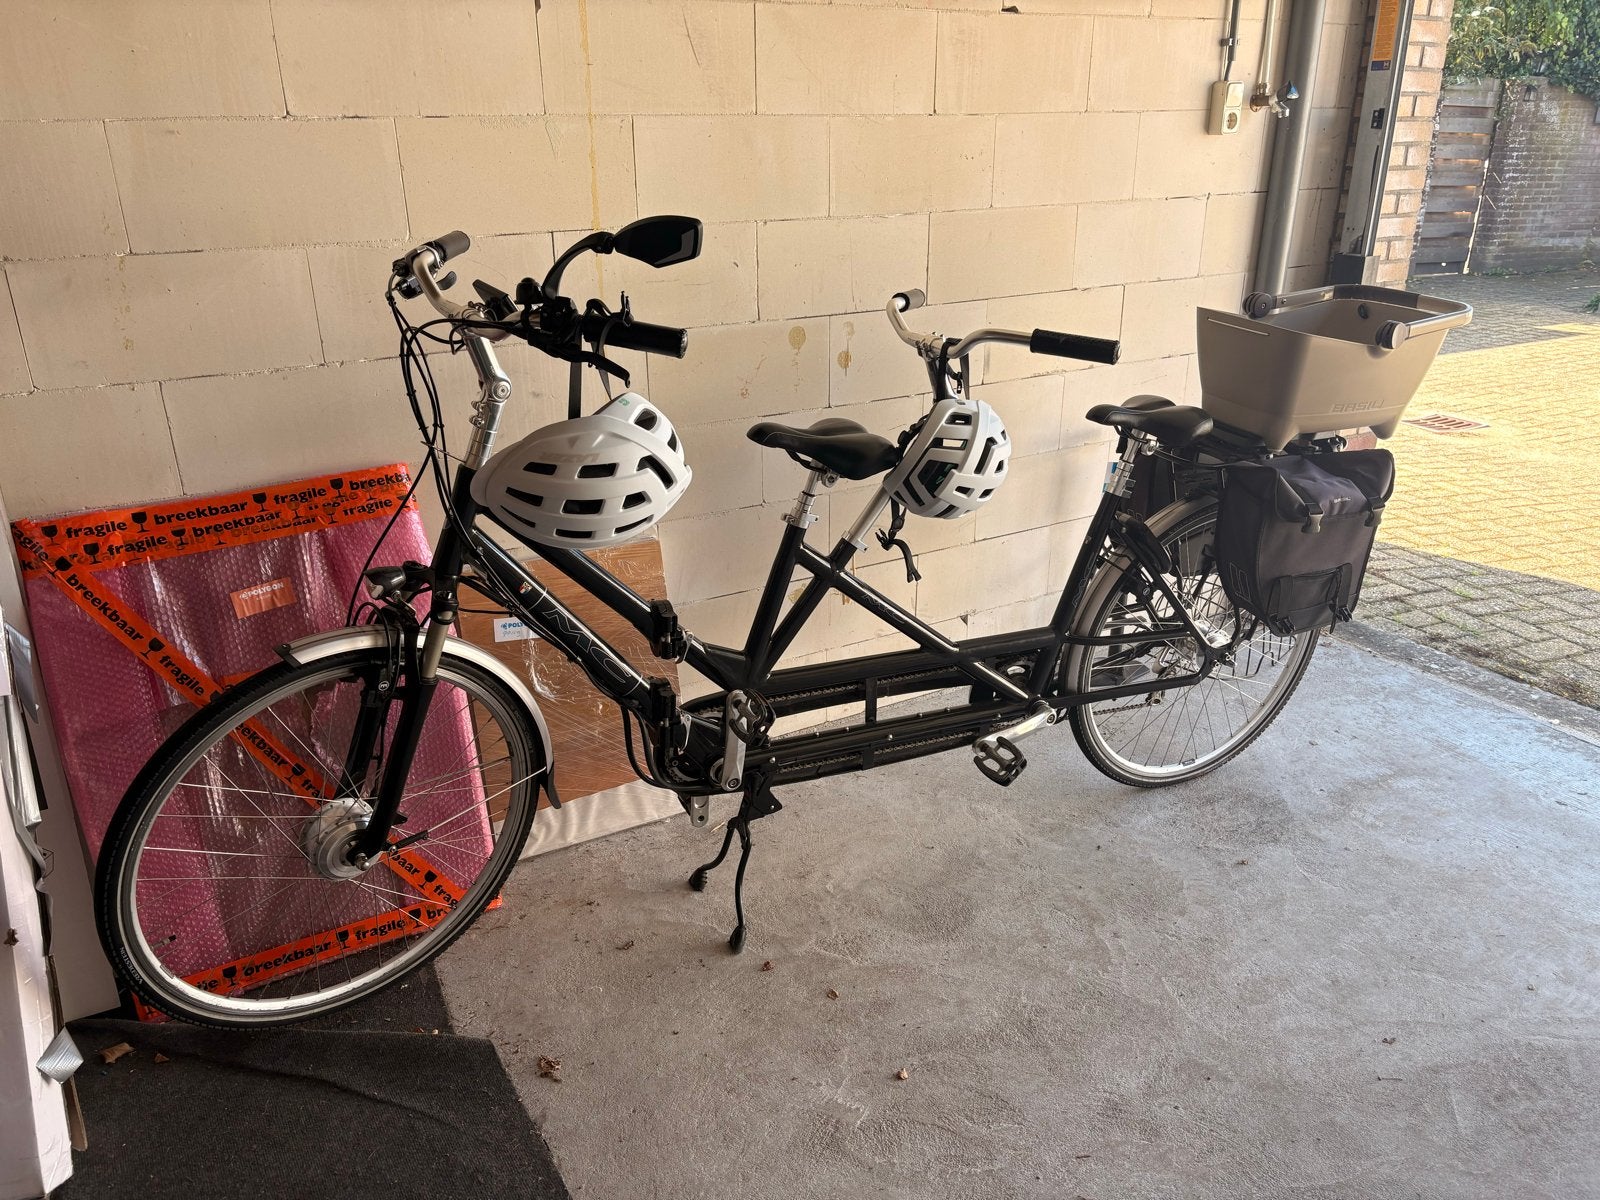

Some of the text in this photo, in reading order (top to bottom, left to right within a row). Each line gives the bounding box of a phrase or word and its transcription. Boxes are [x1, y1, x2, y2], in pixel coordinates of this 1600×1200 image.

[65, 520, 127, 539] fragile
[153, 501, 248, 525] breekbaar
[273, 487, 327, 504] fragile
[107, 535, 168, 556] fragile
[192, 510, 281, 537] breekbaar
[247, 582, 284, 597] POLYGON
[66, 574, 144, 641] breekbaar
[160, 655, 205, 695] fragile
[243, 940, 331, 976] breekbaar
[355, 919, 406, 941] fragile
